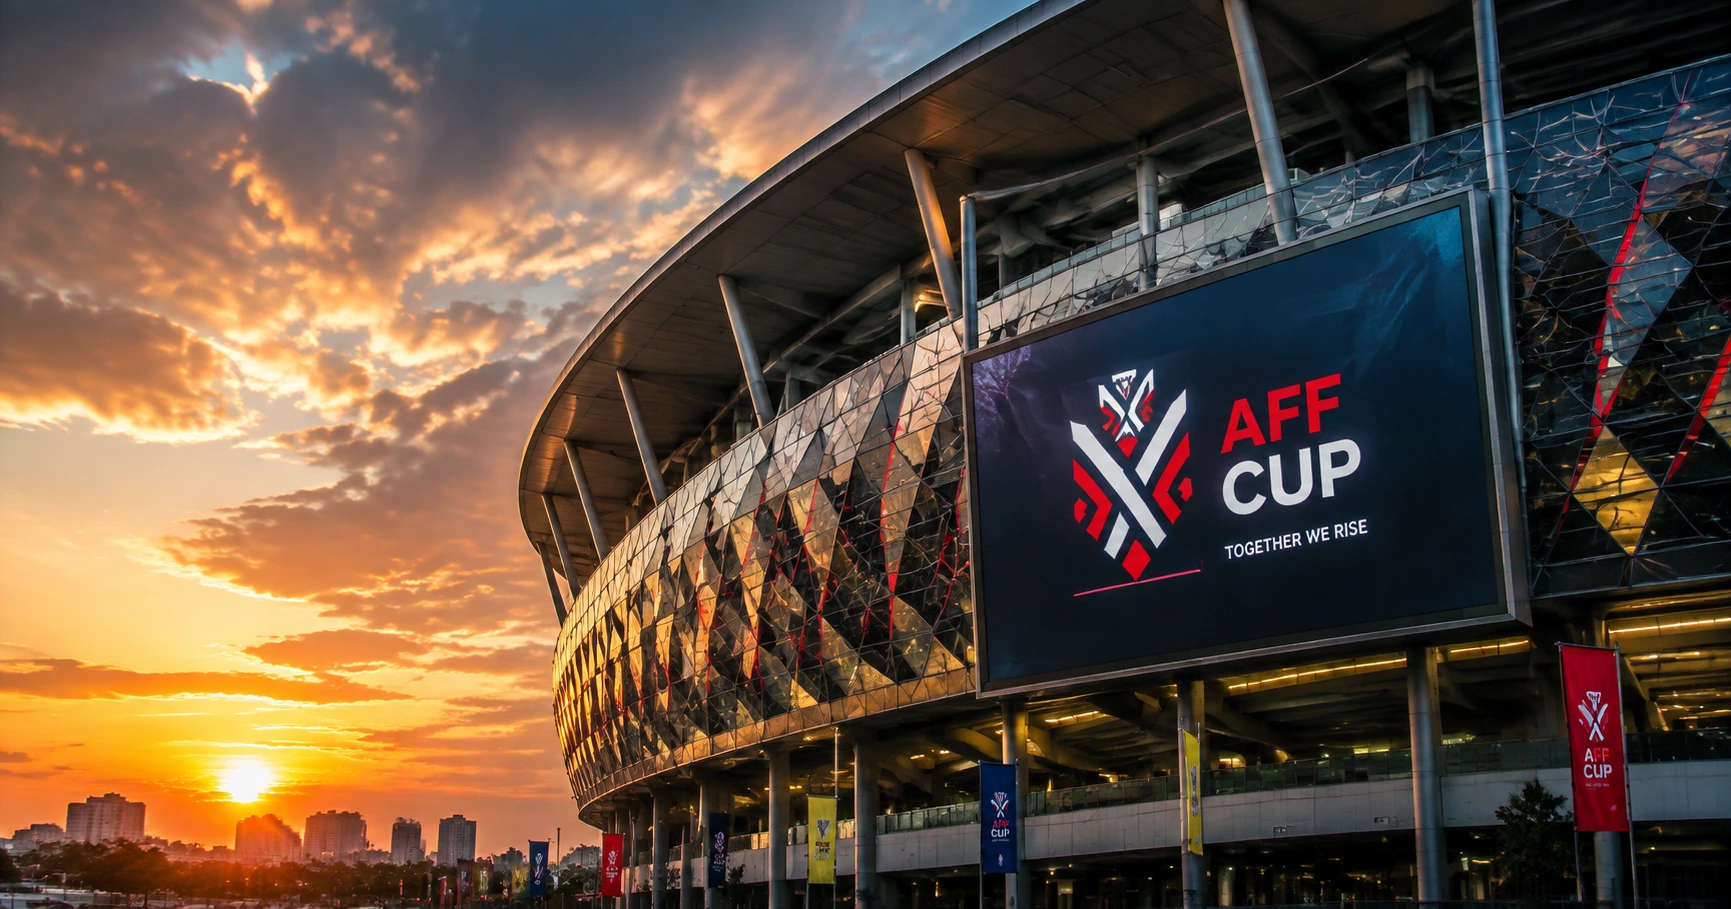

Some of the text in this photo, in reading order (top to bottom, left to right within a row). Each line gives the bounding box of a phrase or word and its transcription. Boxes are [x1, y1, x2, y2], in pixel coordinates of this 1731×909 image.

[1220, 373, 1341, 454] AFF
[1222, 439, 1361, 515] CUP
[1224, 519, 1368, 560] TOGETHER WE RISE
[1584, 747, 1609, 762] AFF
[1583, 764, 1612, 778] CUP
[991, 829, 1010, 838] CUP
